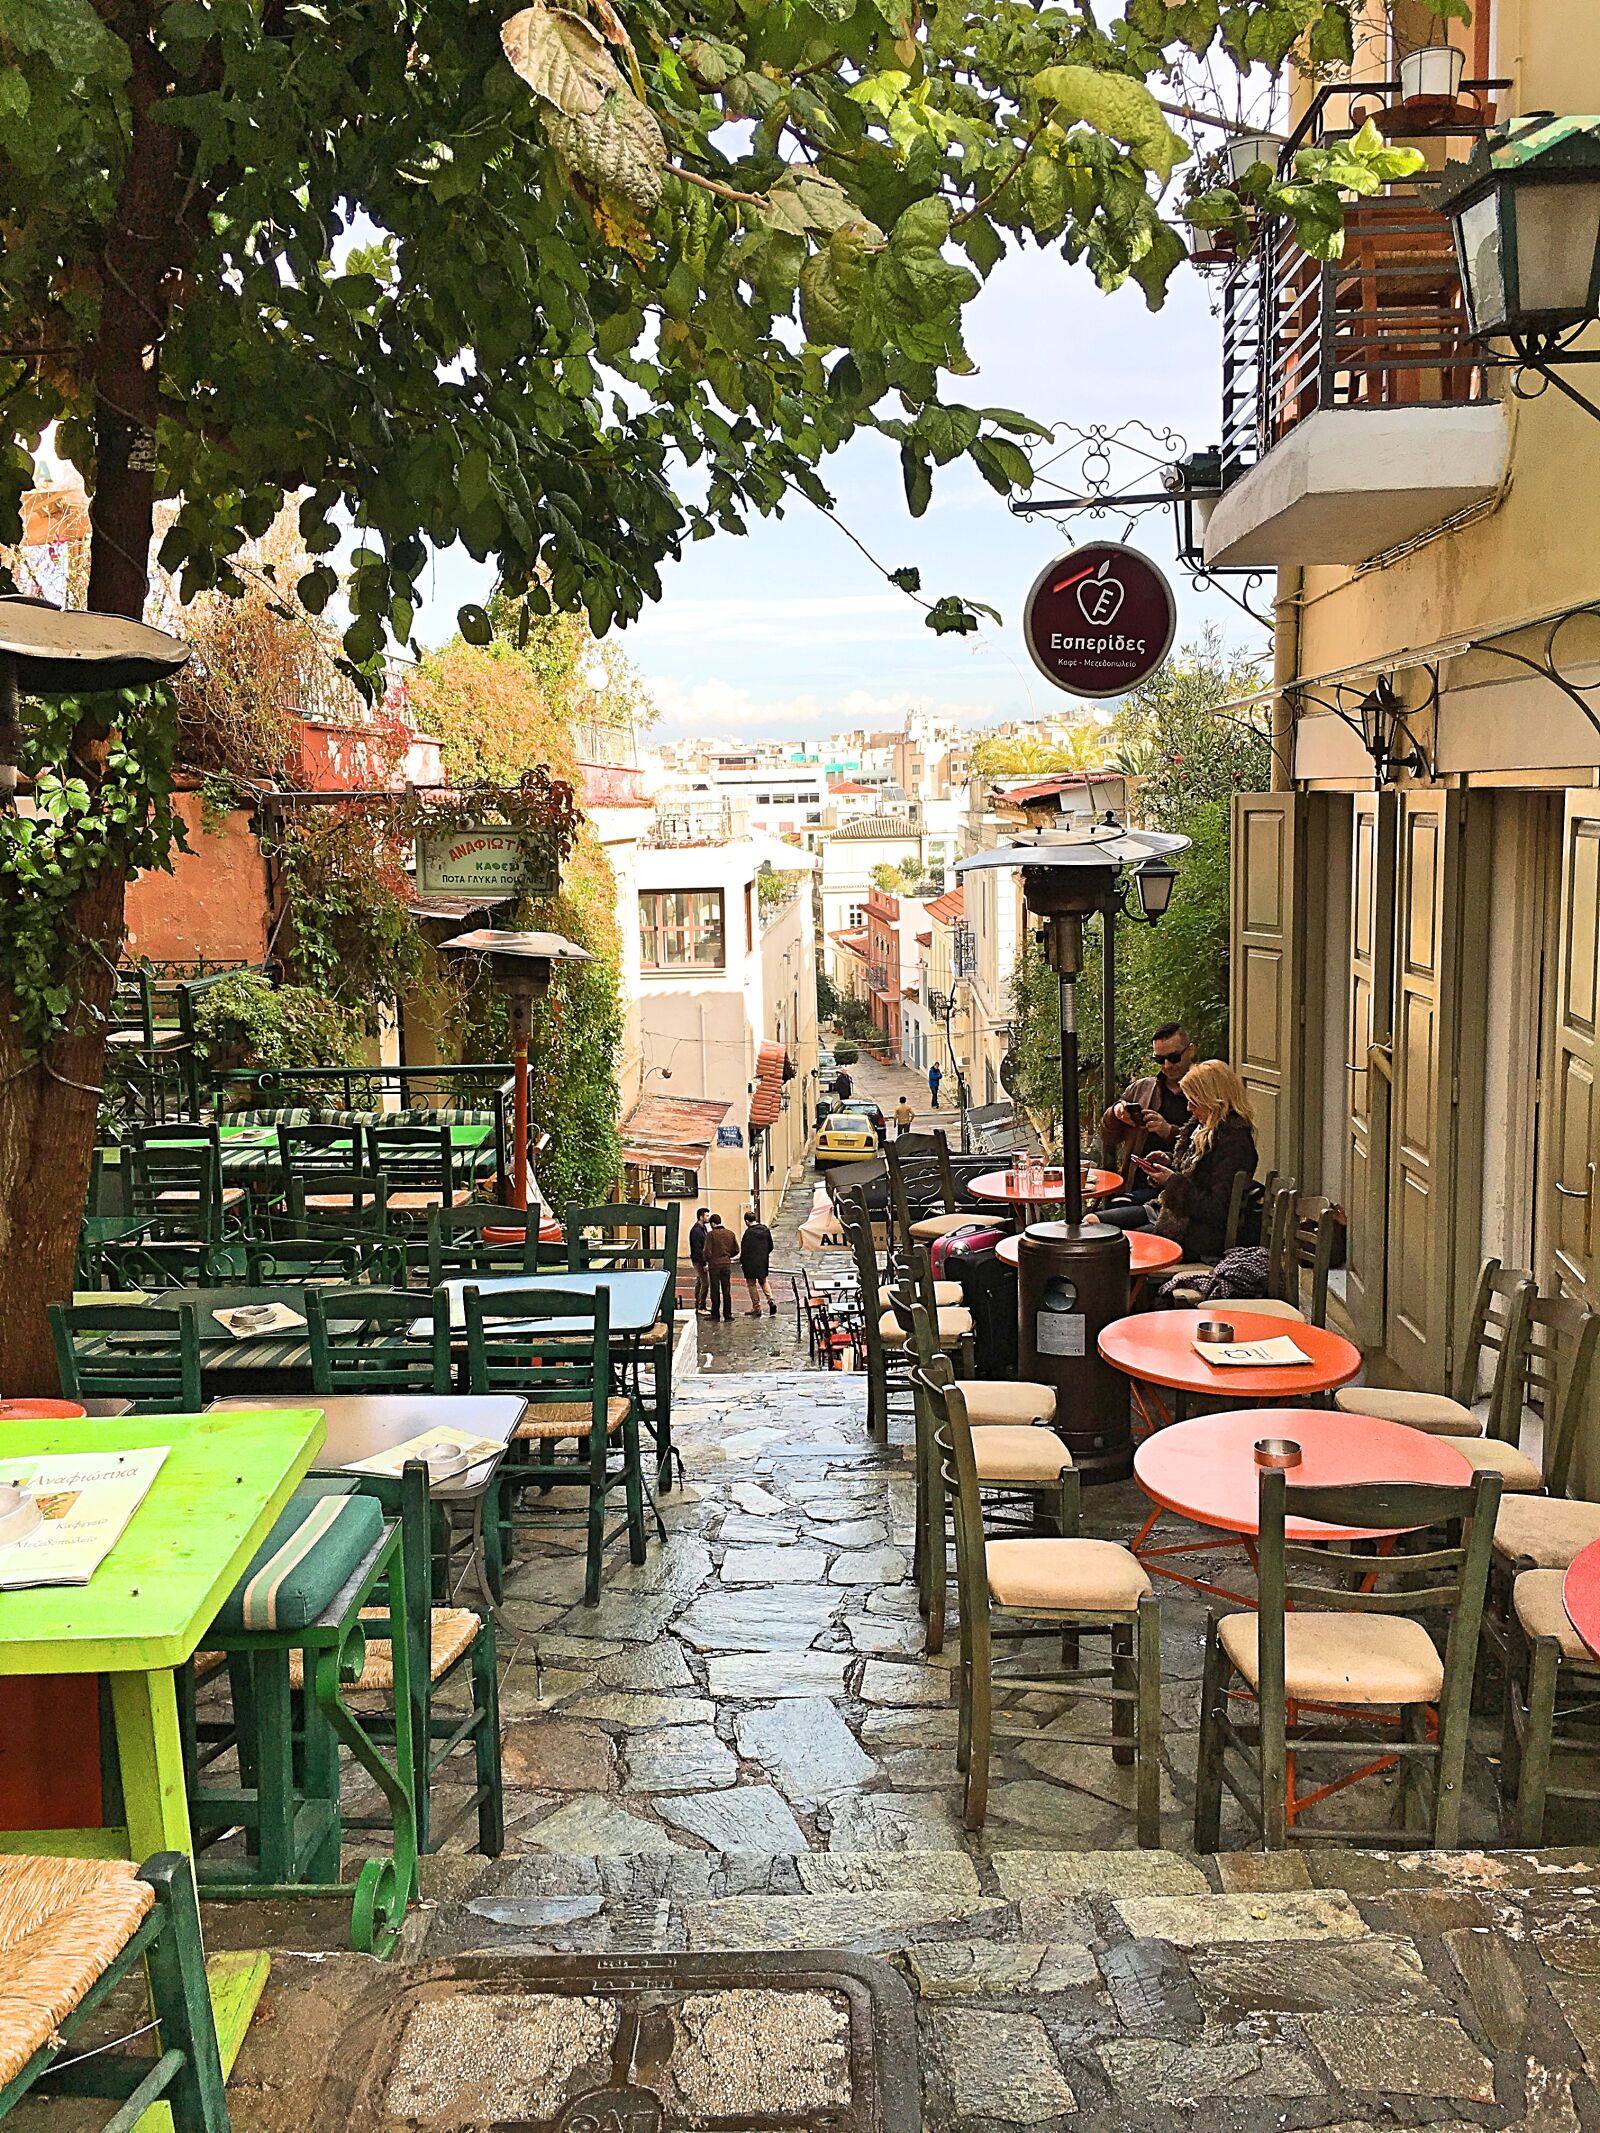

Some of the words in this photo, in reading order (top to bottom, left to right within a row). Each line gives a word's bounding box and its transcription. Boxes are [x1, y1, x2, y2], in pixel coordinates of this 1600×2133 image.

[1050, 632, 1146, 655] Εσπερίδες
[1058, 658, 1078, 667] Καφέ
[1084, 658, 1137, 668] Μεζεδοπωλείο
[442, 874, 465, 883] ΠΟΤΑ
[467, 875, 497, 884] ΓΛΥΚΑ
[29, 1467, 140, 1487] Αναφιώτικα
